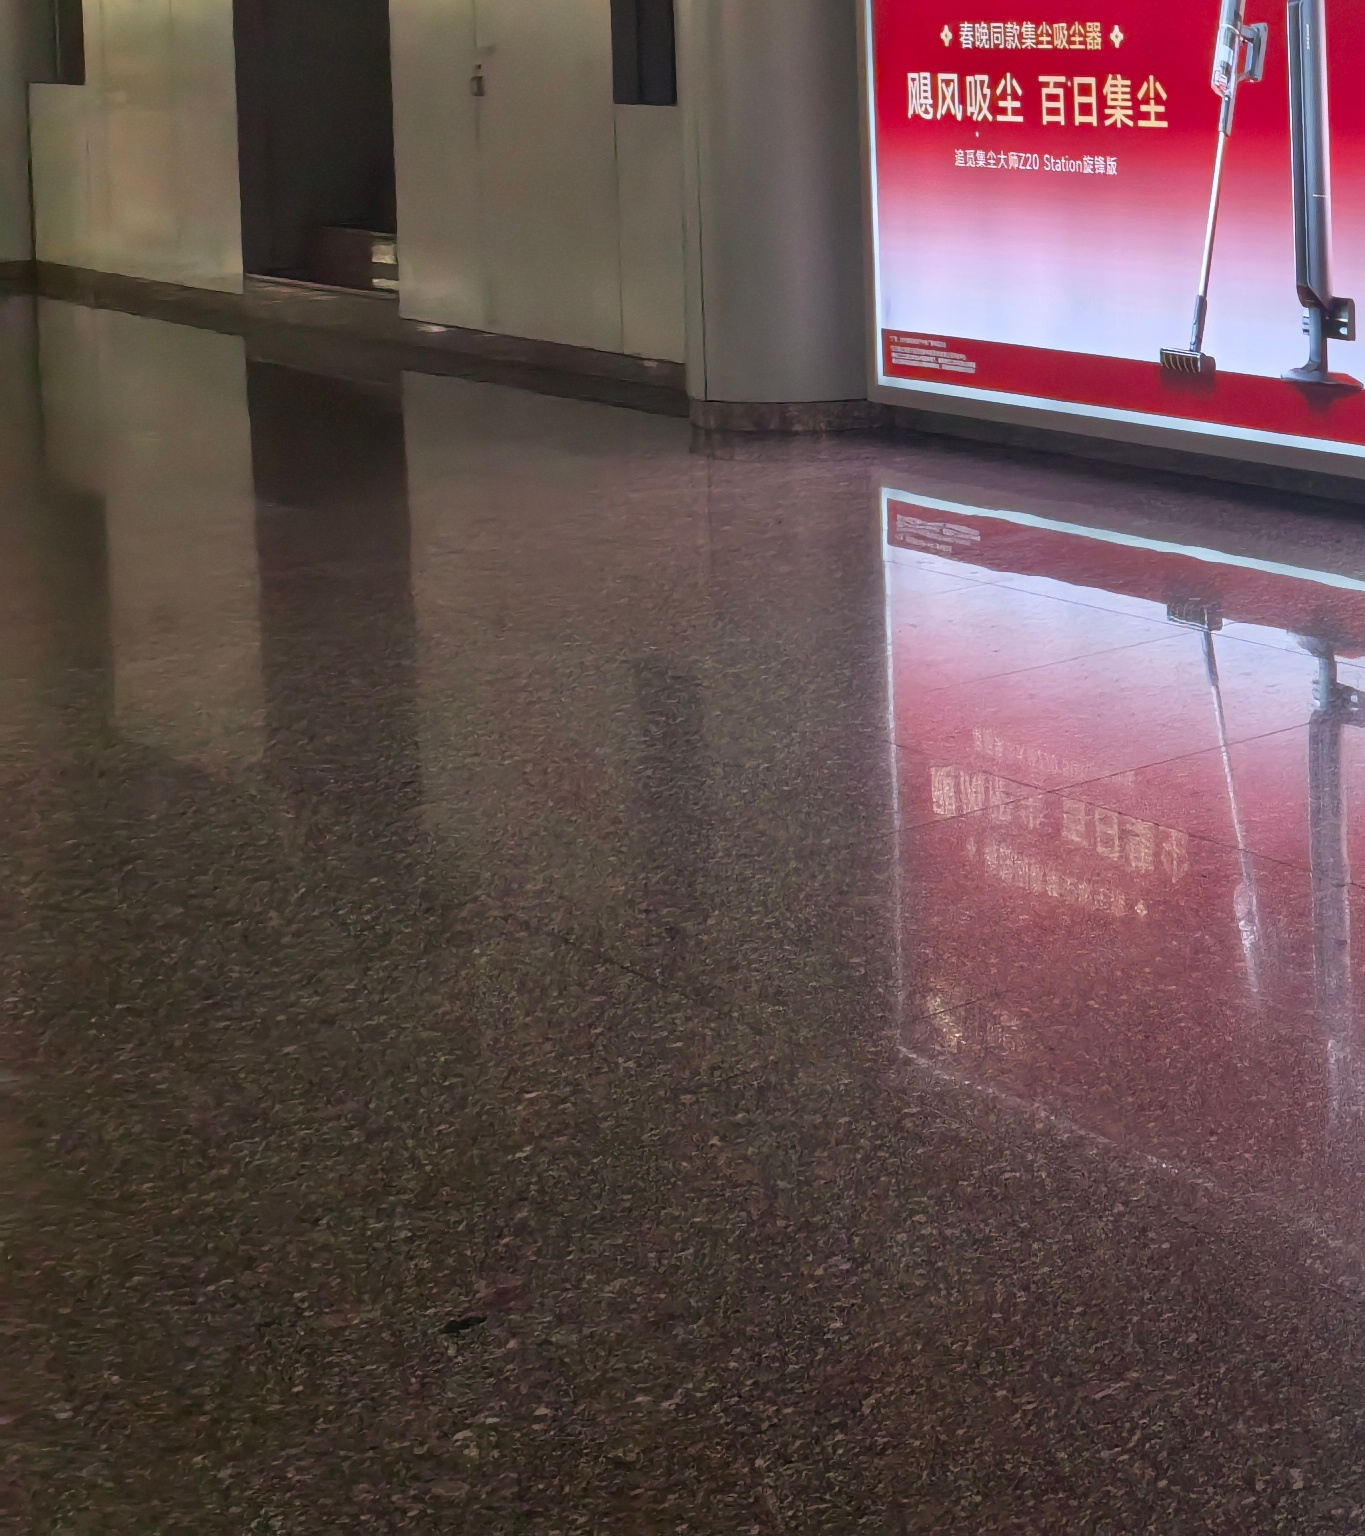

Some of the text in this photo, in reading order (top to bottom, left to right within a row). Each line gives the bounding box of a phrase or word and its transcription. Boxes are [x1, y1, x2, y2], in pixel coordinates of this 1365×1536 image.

[959, 21, 1102, 50] 春晚同款集尘吸尘器
[908, 72, 1168, 128] 飓风吸尘 百日集尘
[955, 149, 1117, 175] 追觅集尘大师Z20 Station旋锋版
